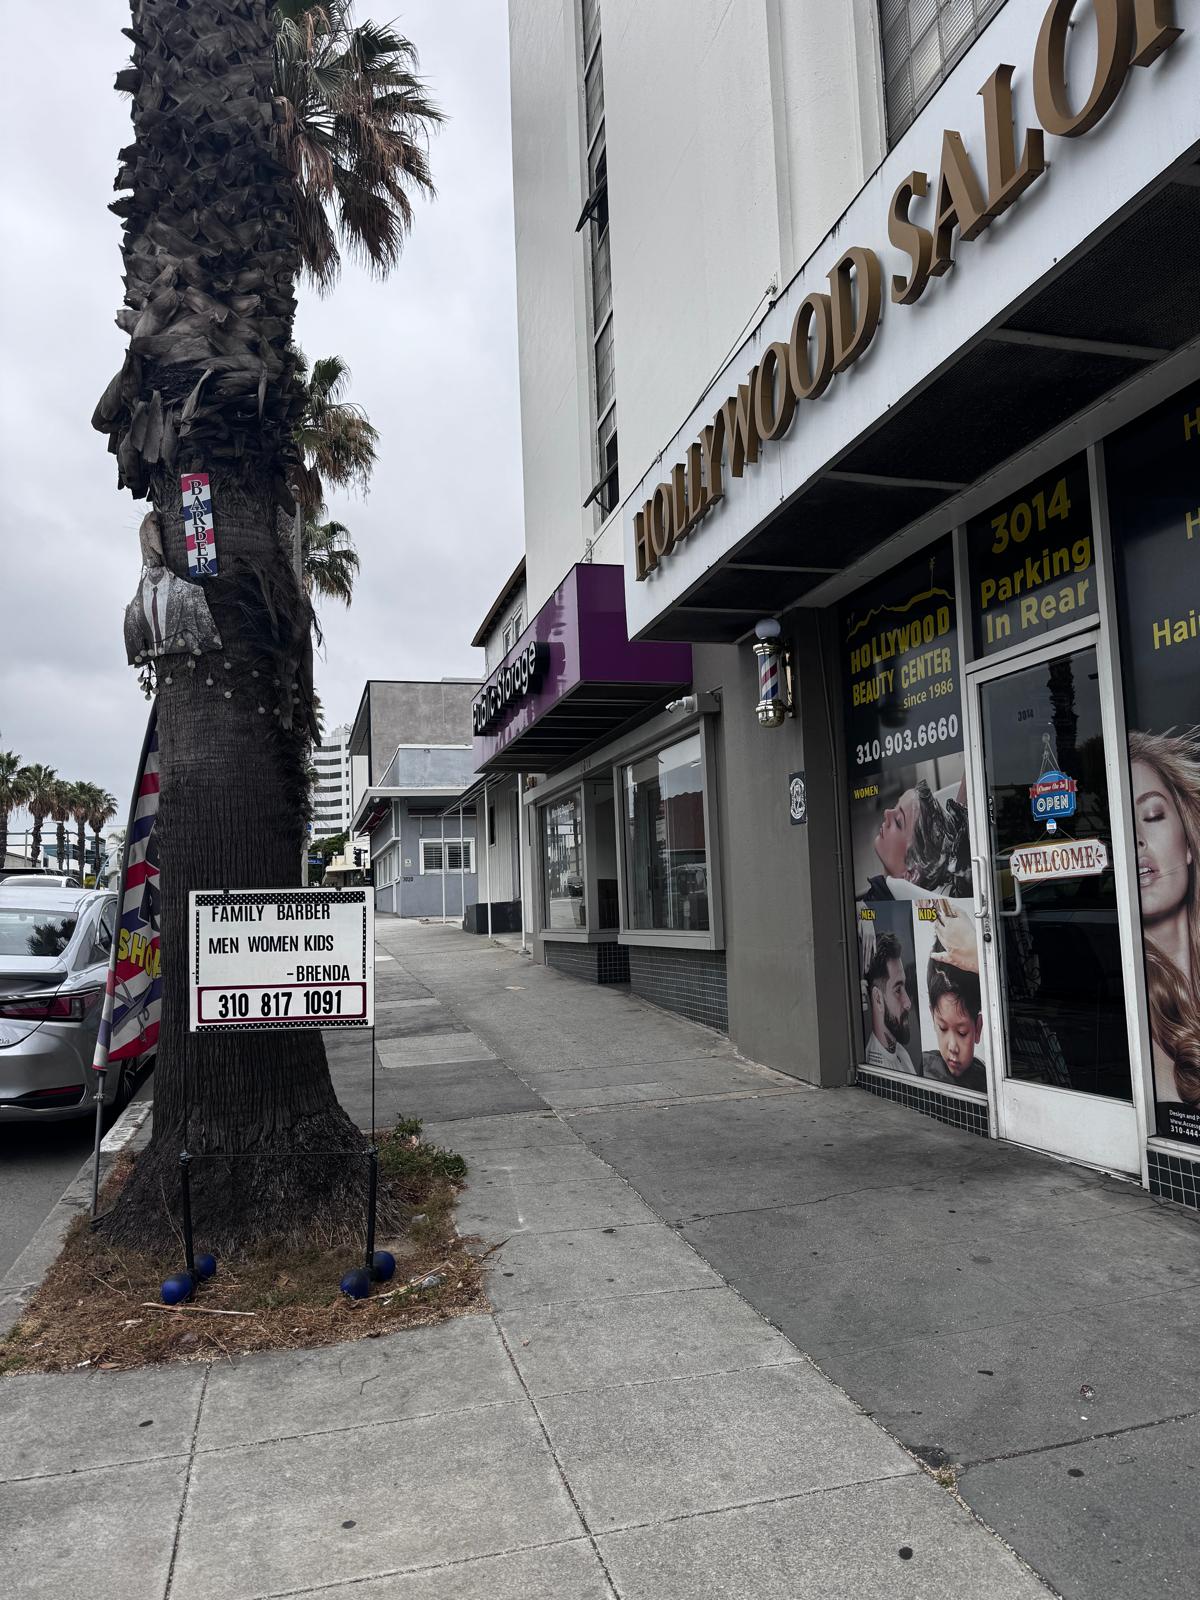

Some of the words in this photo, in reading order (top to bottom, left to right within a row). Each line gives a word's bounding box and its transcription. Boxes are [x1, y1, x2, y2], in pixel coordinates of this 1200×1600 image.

[633, 247, 881, 582] HOLLYWOOD
[189, 480, 212, 574] BARBER
[991, 477, 1071, 554] 3014
[981, 536, 1091, 609] Parking
[986, 613, 1011, 644] In
[1020, 578, 1089, 630] Rear
[1153, 608, 1200, 649] Hai
[851, 606, 950, 674] HOLLYWOOD
[473, 687, 496, 732] Public
[496, 641, 536, 710] Storage
[852, 668, 895, 707] BEAUTY
[901, 647, 951, 689] CENTER
[903, 690, 927, 708] since
[929, 678, 953, 699] 1986
[856, 714, 958, 764] 310.903.6660
[854, 785, 879, 799] WOMEN
[1036, 794, 1069, 812] OPEN
[1019, 845, 1096, 875] WELCOME
[212, 905, 265, 922] FAMILY
[277, 904, 331, 920] BARBER
[861, 909, 876, 920] MEN
[918, 908, 937, 920] KIDS
[209, 937, 239, 954] MEN
[248, 936, 299, 953] WOMEN
[304, 935, 334, 951] KIDS
[218, 993, 249, 1018] 310
[261, 991, 292, 1017] 817
[304, 990, 342, 1014] 1091
